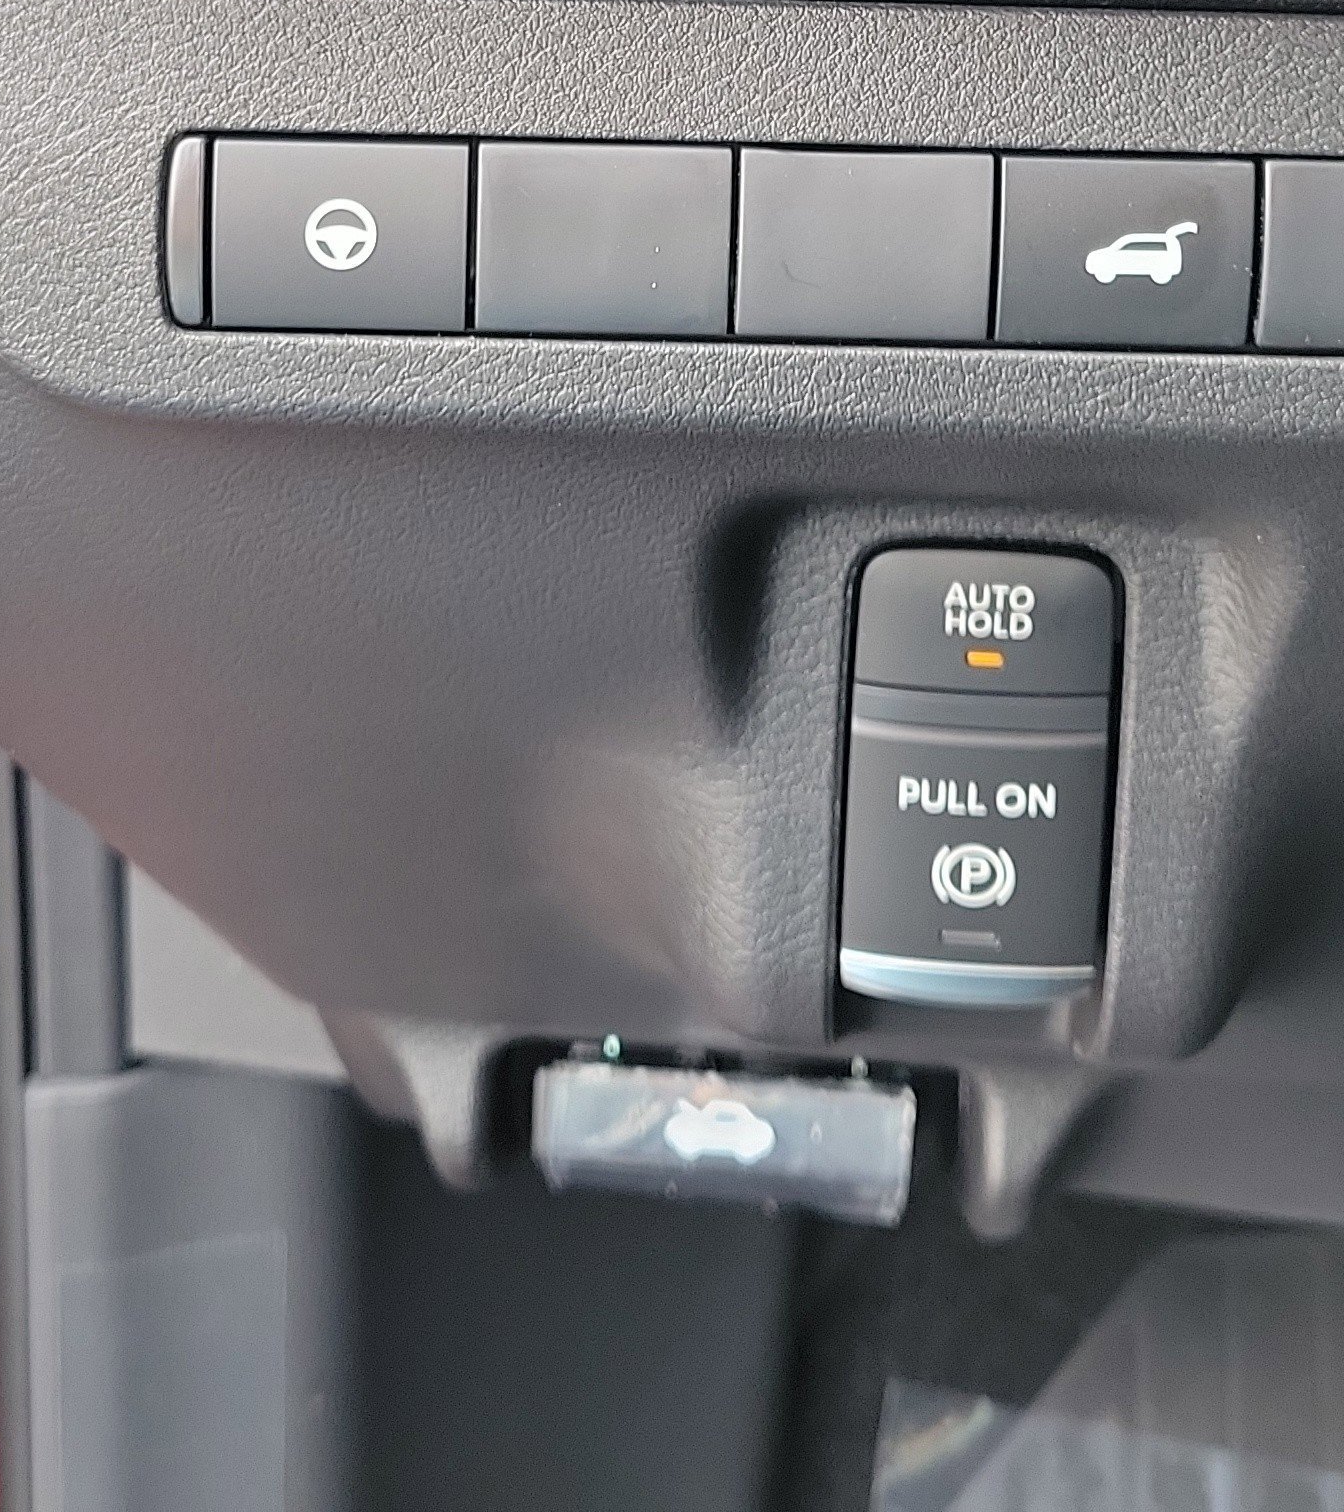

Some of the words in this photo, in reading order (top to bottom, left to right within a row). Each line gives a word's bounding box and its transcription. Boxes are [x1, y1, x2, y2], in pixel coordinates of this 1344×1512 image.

[944, 582, 1036, 613] AUTO
[945, 609, 1034, 640] HOLD
[898, 776, 988, 817] PULL
[995, 782, 1056, 819] ON
